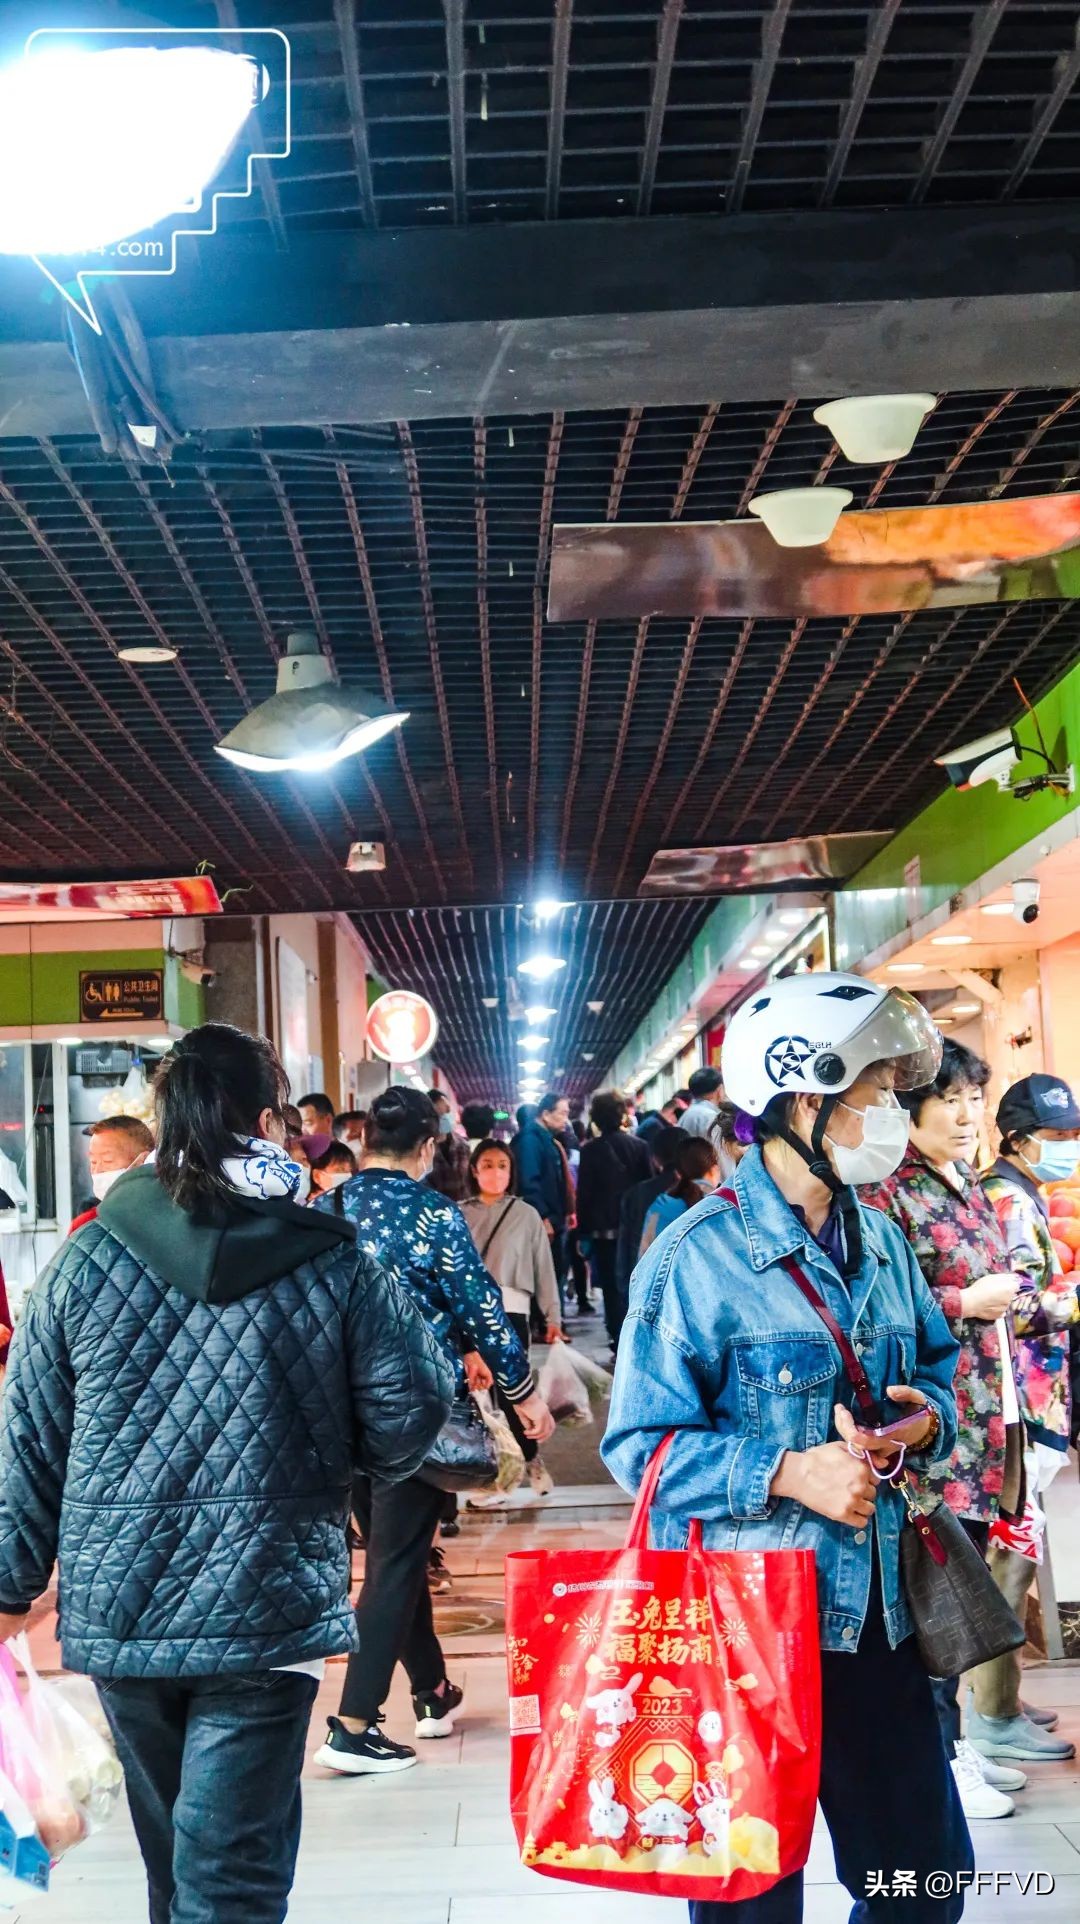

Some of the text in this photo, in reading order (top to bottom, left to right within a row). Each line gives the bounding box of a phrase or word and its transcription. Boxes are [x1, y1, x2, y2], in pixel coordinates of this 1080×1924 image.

[123, 979, 159, 993] 公共卫生间
[608, 1595, 712, 1631] 玉兔呈祥
[604, 1632, 712, 1666] 福聚扬商
[642, 1698, 682, 1715] 2023
